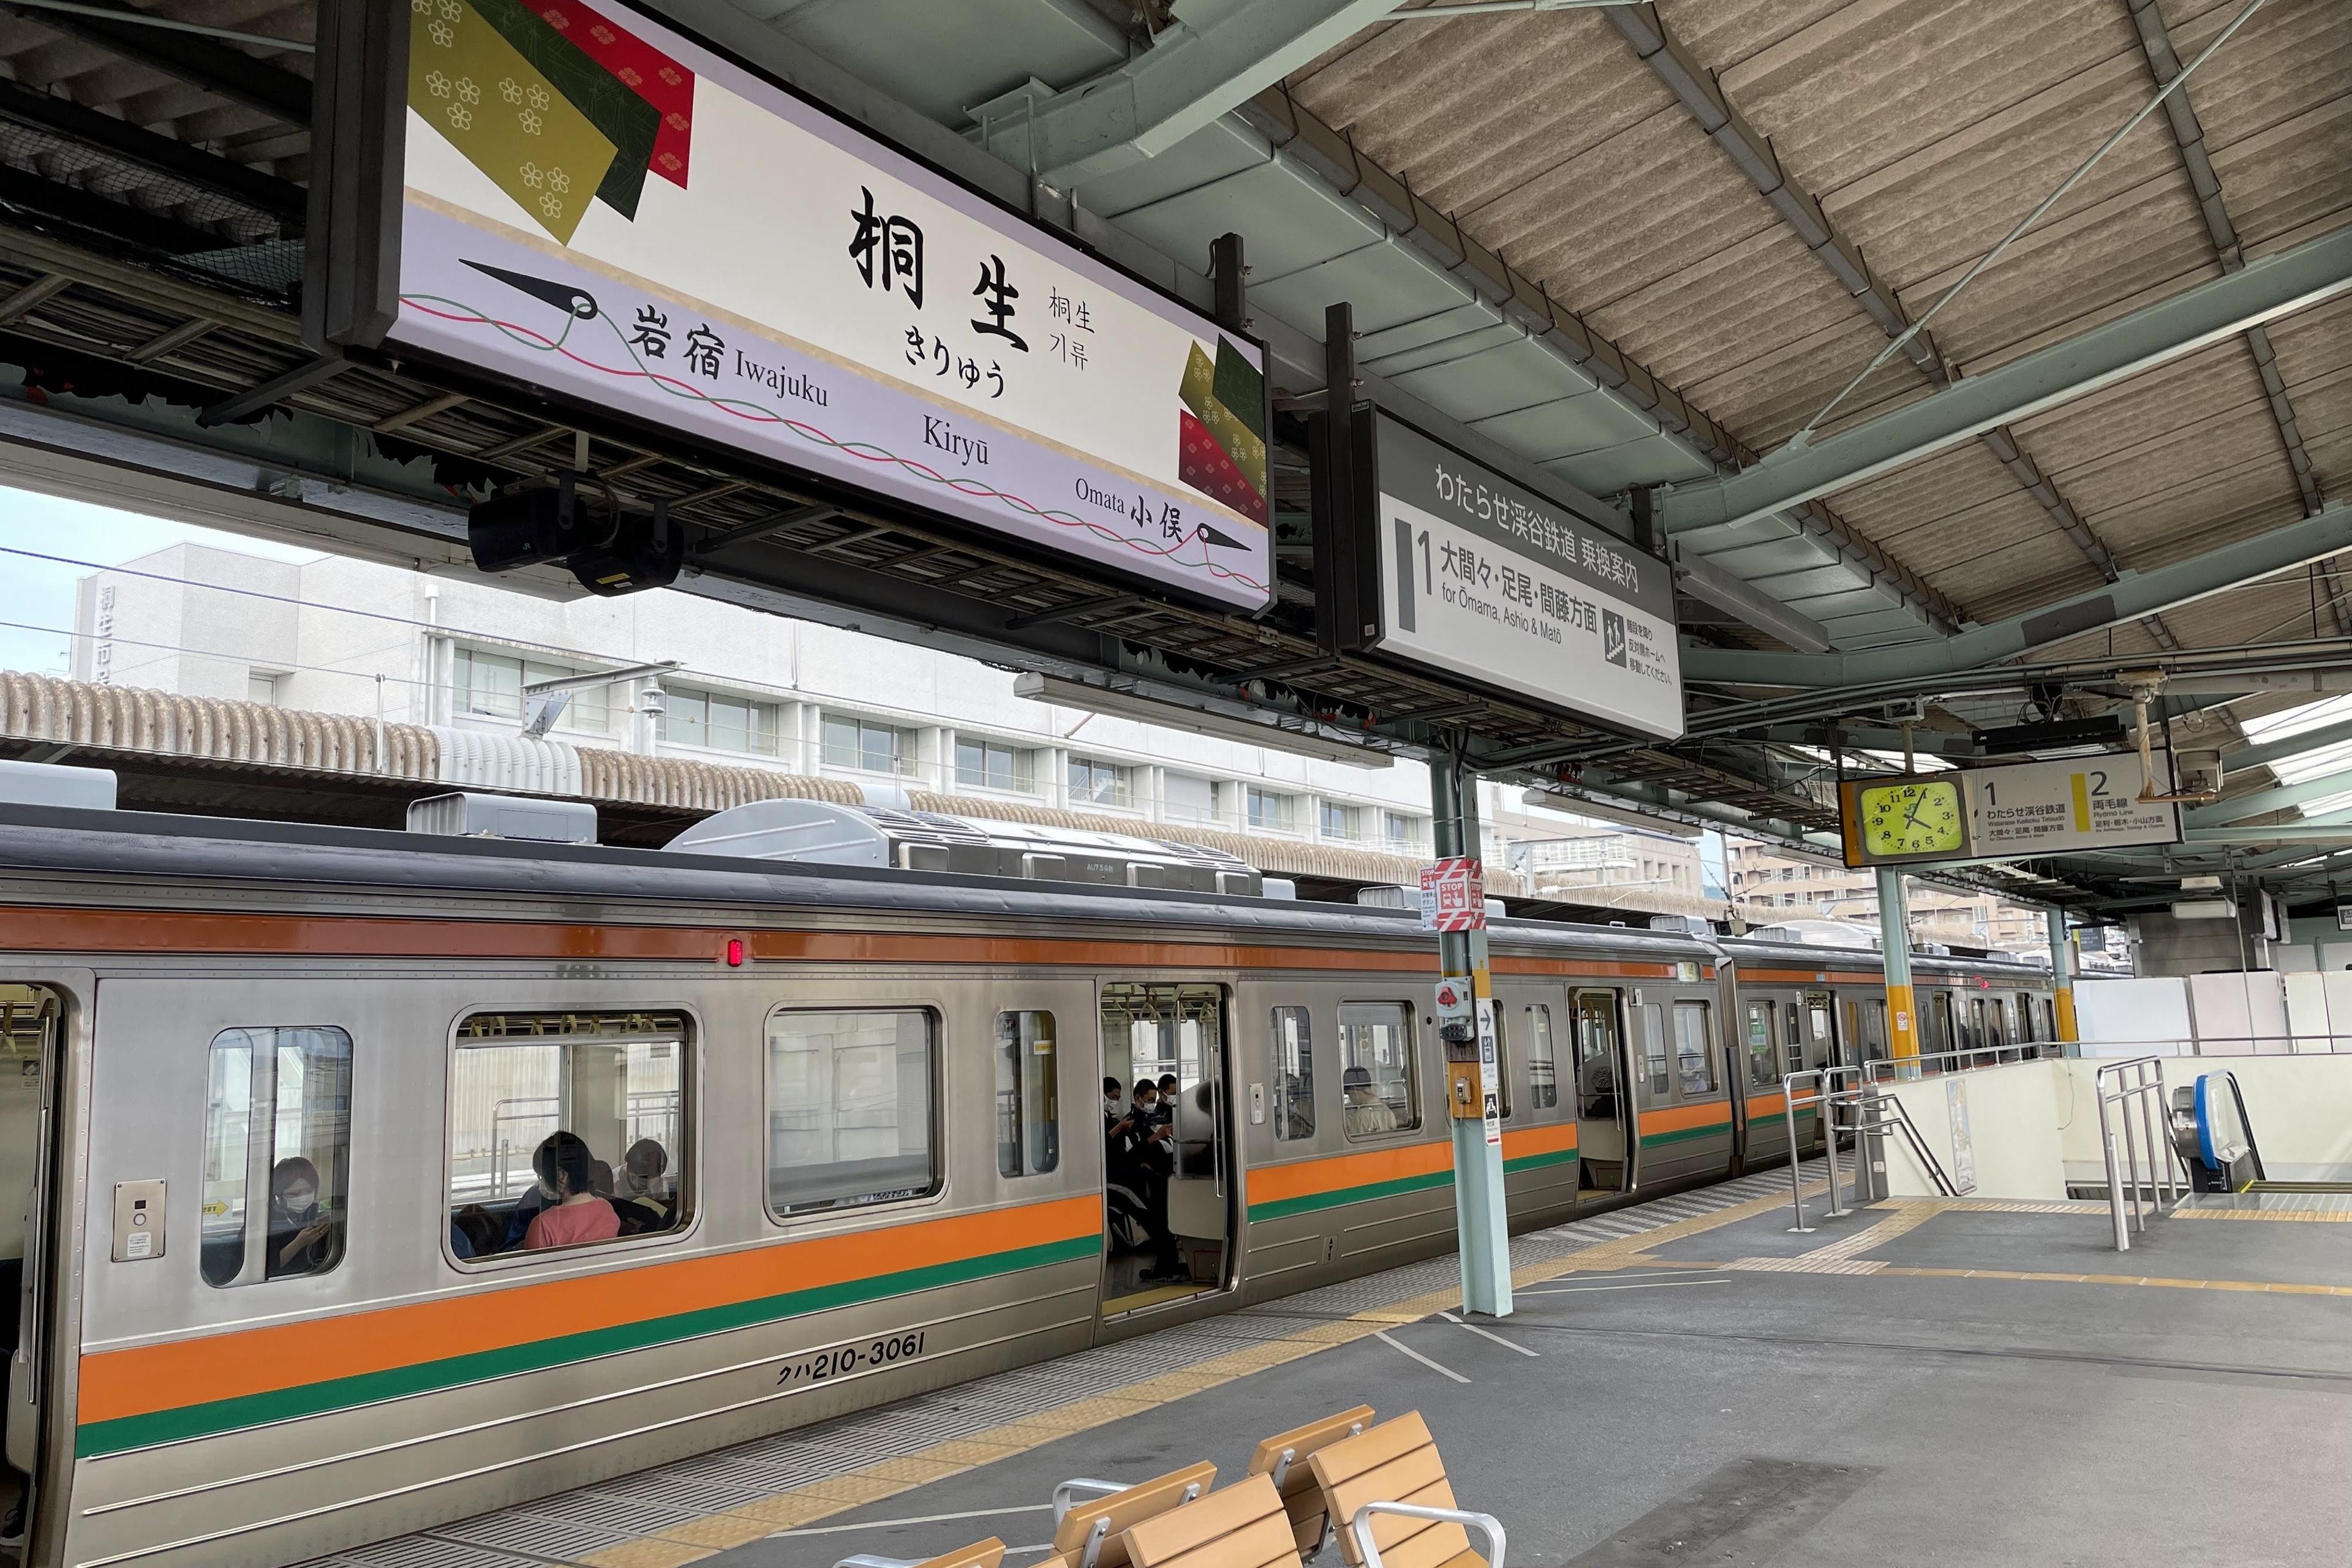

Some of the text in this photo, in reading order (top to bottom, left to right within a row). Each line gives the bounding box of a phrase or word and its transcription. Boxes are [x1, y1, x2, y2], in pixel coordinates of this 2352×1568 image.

[848, 186, 1028, 353] 桐生
[1049, 286, 1095, 334] 桐生
[628, 304, 726, 380] 岩宿
[1050, 334, 1088, 371] 기류
[735, 349, 828, 407] Iwajuku
[922, 415, 989, 466] Kiryū
[1076, 478, 1183, 543] Omata 小俣
[1435, 463, 1639, 594] わたらせ渓谷鉄道 乗換案内
[1417, 529, 1432, 595] 1
[1442, 581, 1562, 644] for Ōmama, Ashio & Matō
[1902, 788, 1916, 797] 12
[1985, 782, 1996, 806] 1
[2090, 771, 2109, 796] 2
[2092, 798, 2128, 810] 両毛線
[1879, 804, 1891, 813] 10
[1987, 804, 2065, 820] わたらせ渓谷鉄道
[1925, 836, 1933, 845] 5
[777, 1331, 925, 1385] クハ210-3061
